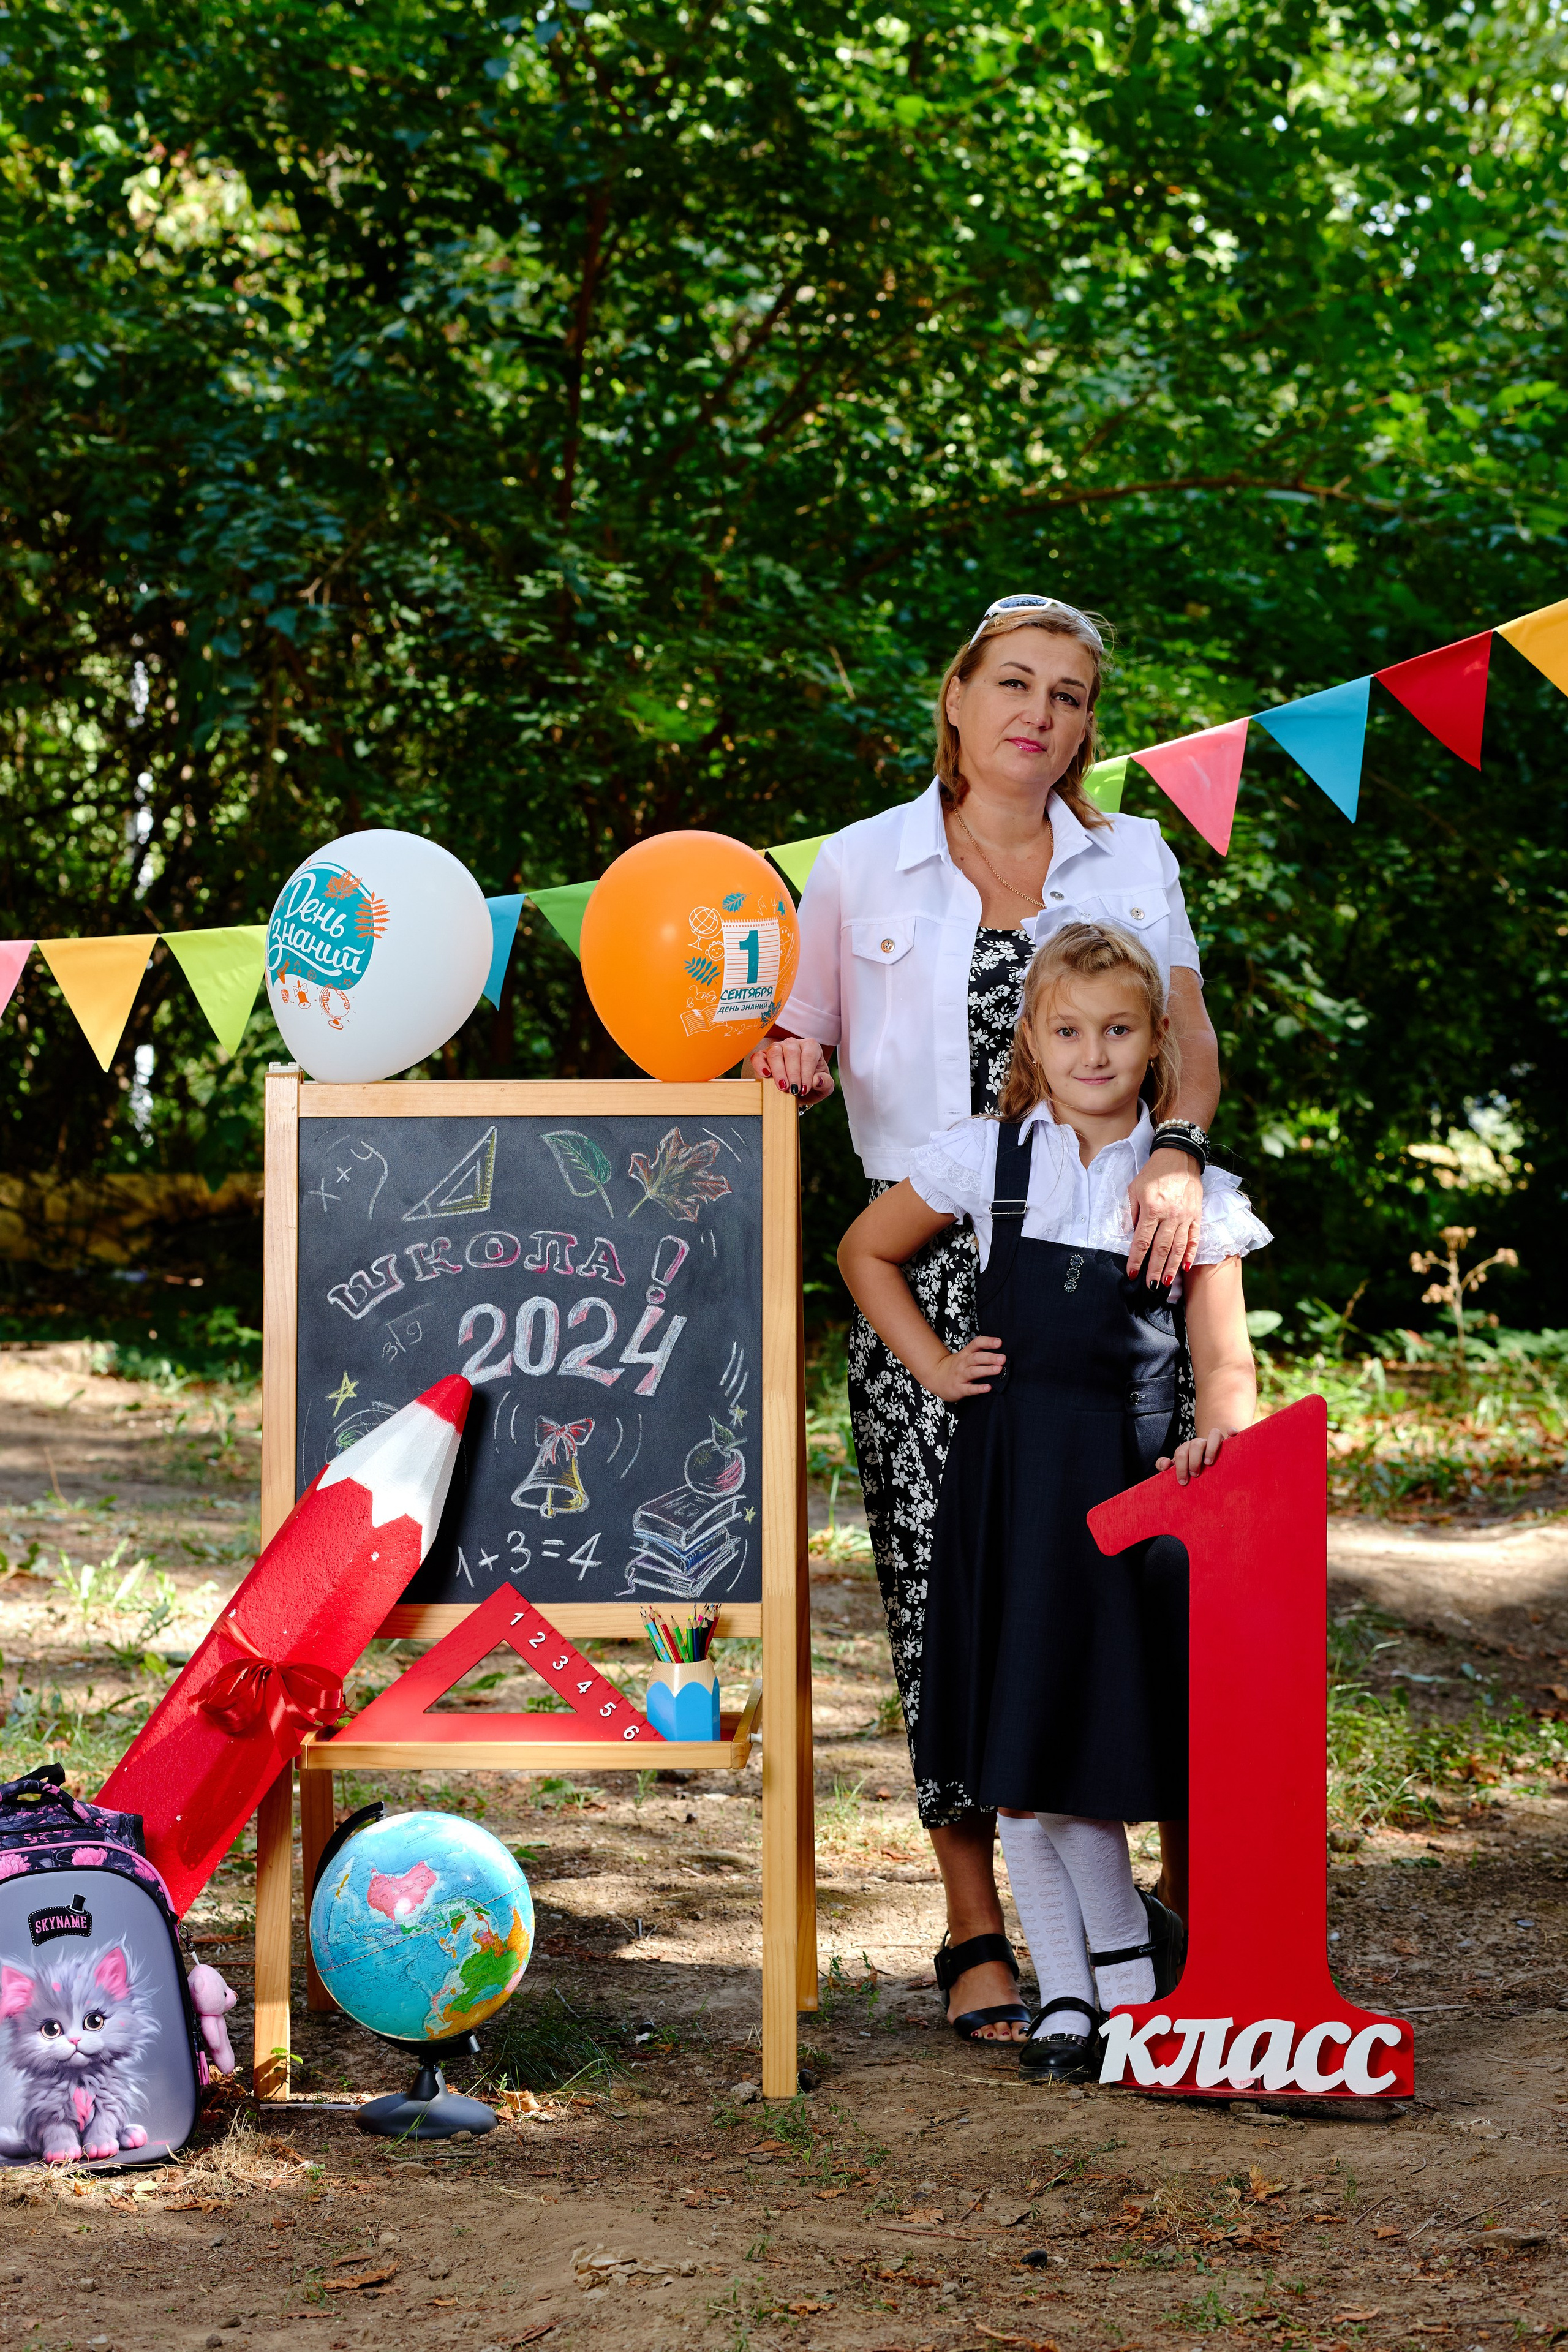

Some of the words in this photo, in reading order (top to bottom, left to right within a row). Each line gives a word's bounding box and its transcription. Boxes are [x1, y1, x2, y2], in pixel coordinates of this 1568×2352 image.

[284, 872, 347, 938] День
[739, 930, 759, 984] 1
[717, 1005, 740, 1014] ДЕНЬ
[741, 1001, 767, 1011] ЗНАНИЙ
[720, 986, 773, 1001] СЕНТЯБРЯ
[457, 1295, 687, 1396] 2024
[510, 1611, 525, 1626] 1
[528, 1631, 548, 1649] 2
[552, 1655, 569, 1672] 3
[576, 1679, 593, 1695] 4
[599, 1701, 617, 1717] 5
[623, 1724, 640, 1741] 6
[1086, 1393, 1415, 2102] 1
[35, 1915, 88, 1934] SKYNAME
[1098, 2013, 1402, 2095] класс
